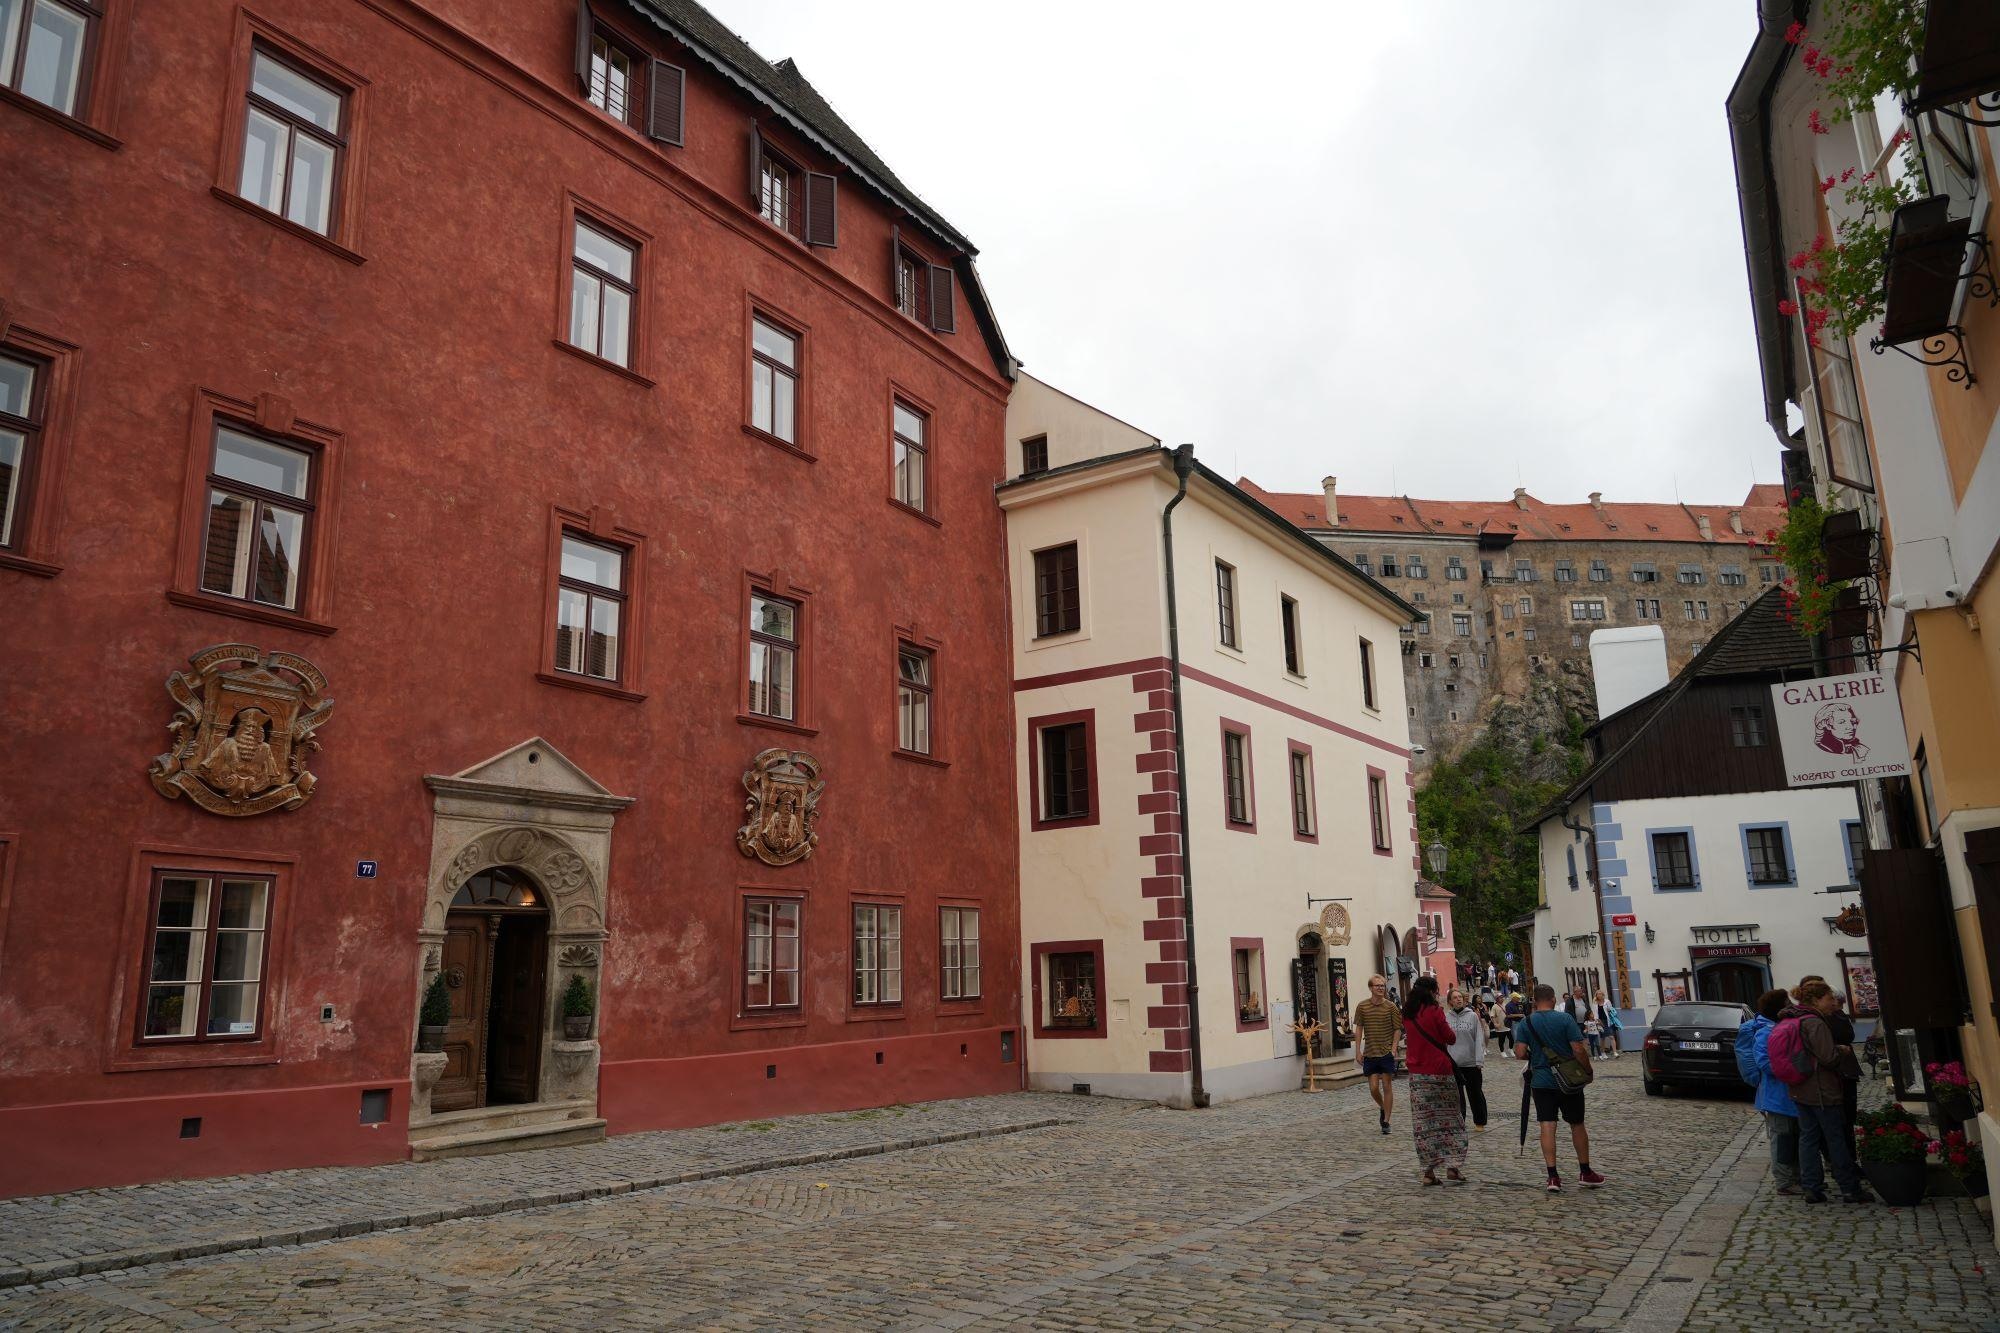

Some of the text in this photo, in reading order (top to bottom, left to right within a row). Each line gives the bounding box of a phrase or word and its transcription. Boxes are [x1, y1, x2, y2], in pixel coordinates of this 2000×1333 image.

[1783, 677, 1885, 705] GALERIE
[1793, 763, 1906, 783] MOZART COLLECTION
[362, 864, 373, 874] 77
[1694, 927, 1760, 944] HOTEL
[1707, 948, 1733, 956] HOTEL
[1614, 936, 1630, 1004] TERASA
